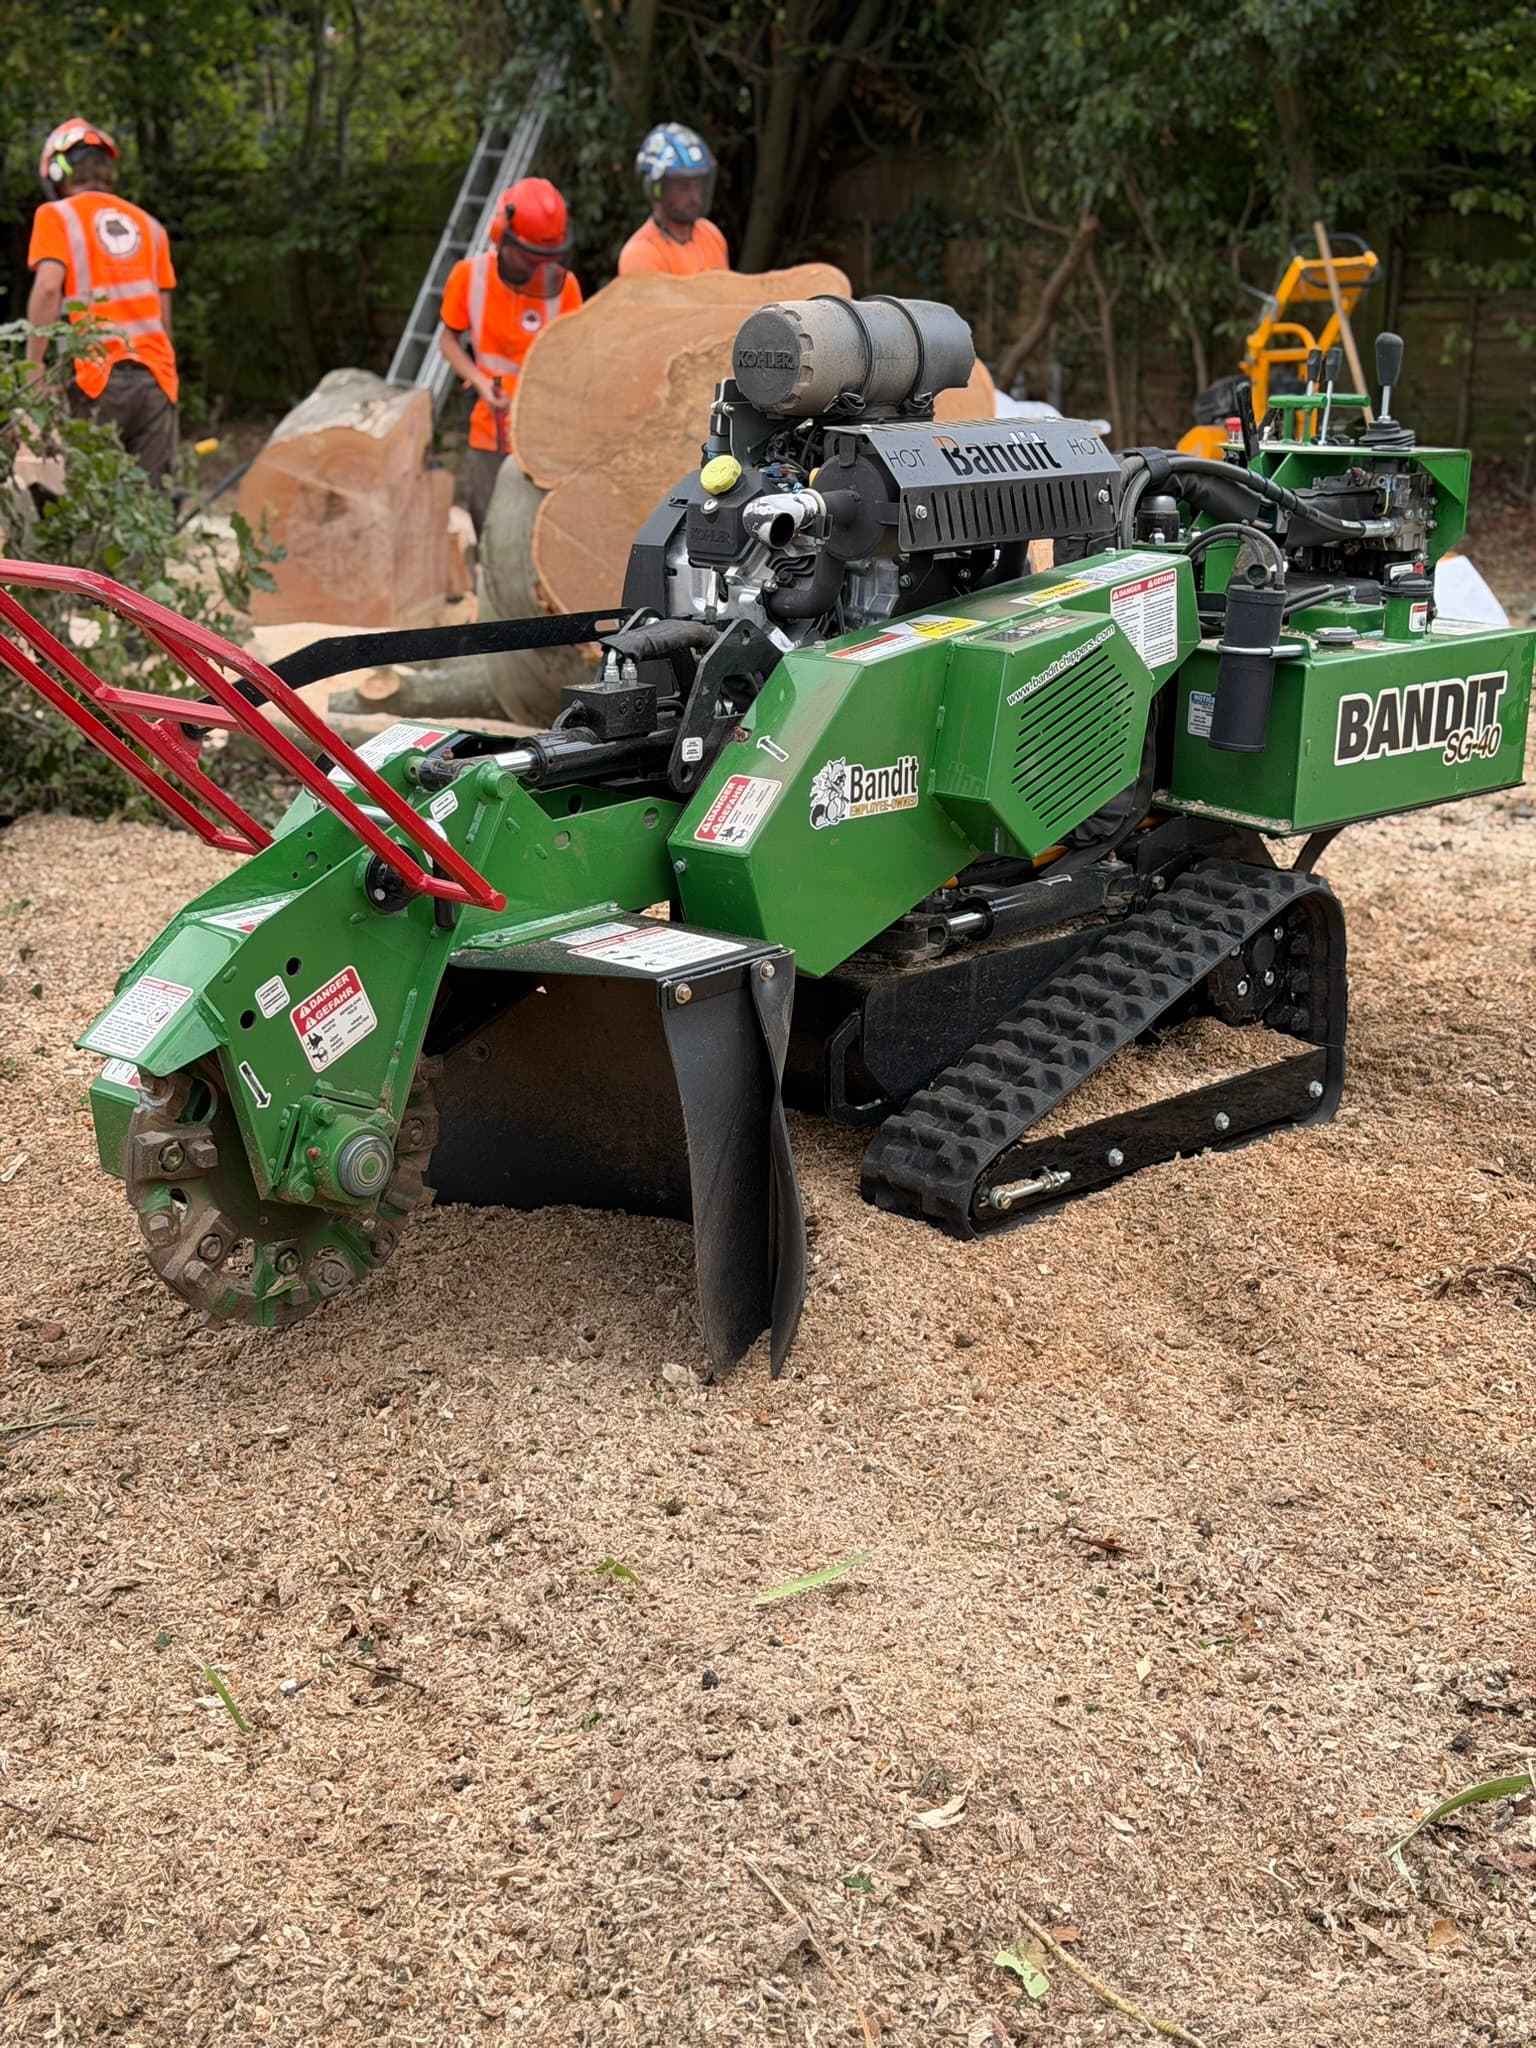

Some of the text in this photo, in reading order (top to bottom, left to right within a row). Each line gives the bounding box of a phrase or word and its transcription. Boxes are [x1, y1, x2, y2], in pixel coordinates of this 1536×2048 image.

[736, 349, 794, 370] KOHLER
[884, 430, 1104, 477] HOT Bandit HOT
[1119, 583, 1142, 597] DANGER
[1336, 675, 1506, 762] BANDIT
[1444, 725, 1501, 764] SG-40
[850, 757, 918, 804] Bandit
[707, 782, 737, 822] DANGER
[718, 784, 745, 822] GEFAHR
[309, 973, 350, 1009] DANGER
[315, 986, 354, 1020] GEFAHR
